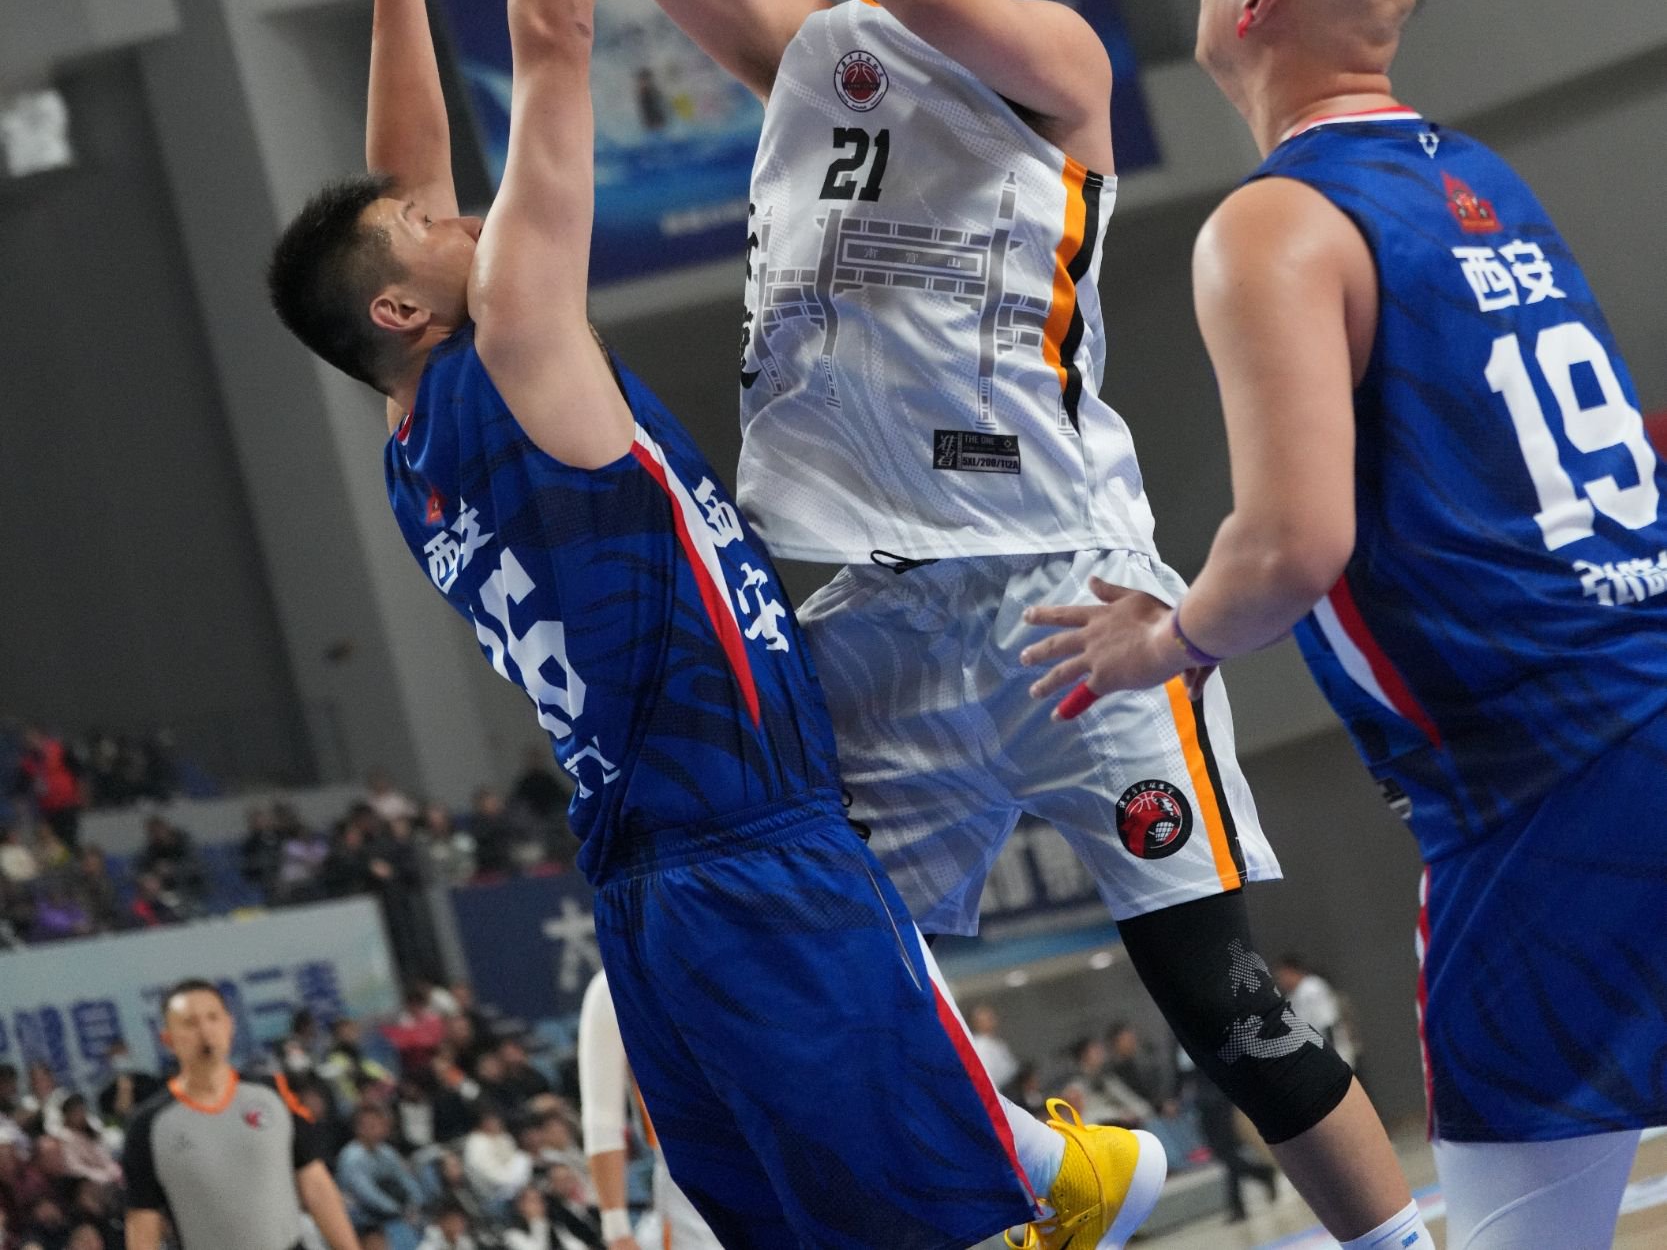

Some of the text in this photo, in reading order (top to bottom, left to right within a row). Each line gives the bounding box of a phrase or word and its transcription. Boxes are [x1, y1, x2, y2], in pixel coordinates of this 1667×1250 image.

[819, 126, 891, 203] 21
[1451, 238, 1567, 313] 西安
[1484, 321, 1660, 552] 19
